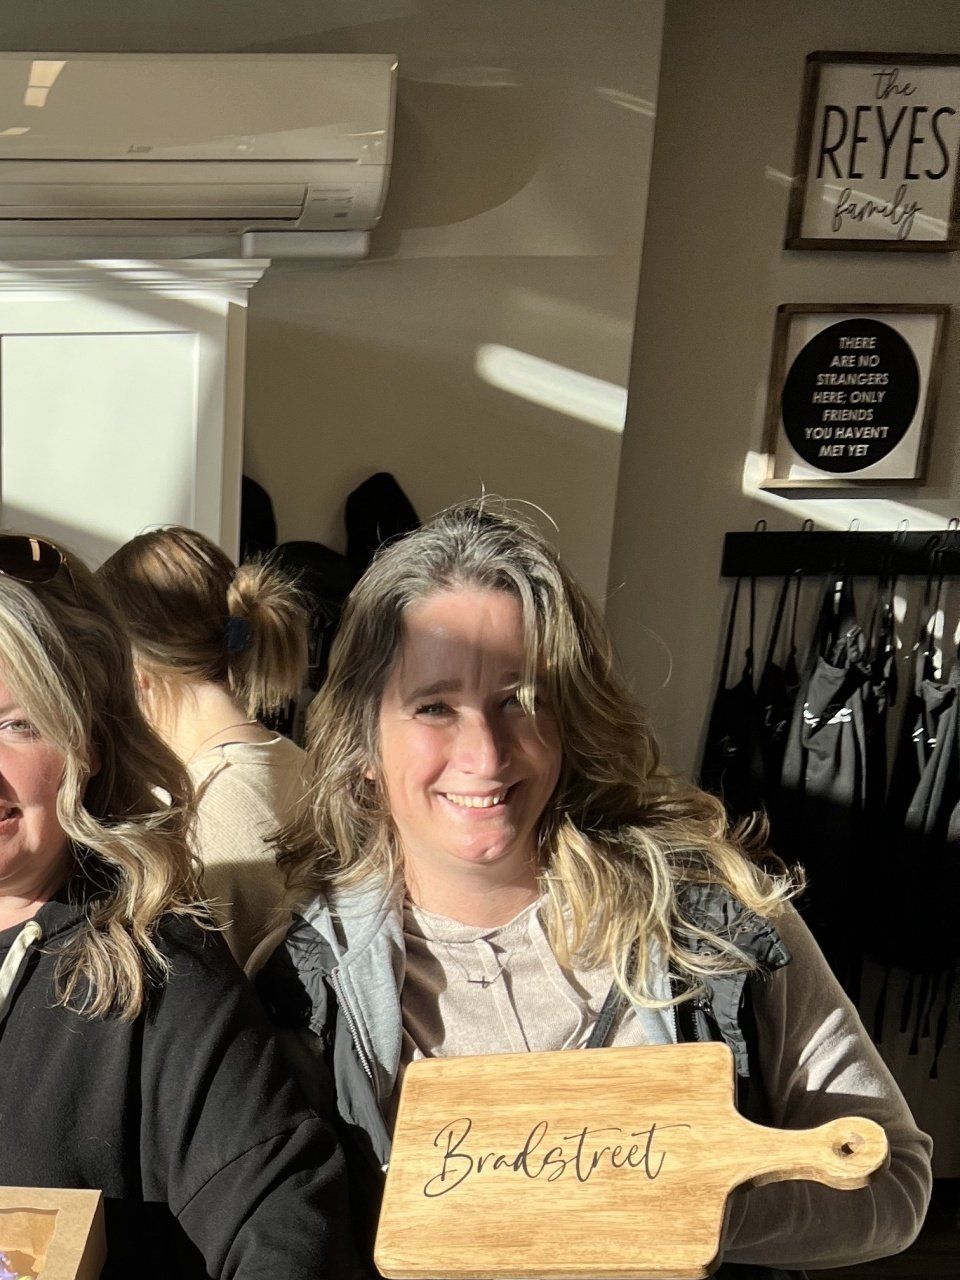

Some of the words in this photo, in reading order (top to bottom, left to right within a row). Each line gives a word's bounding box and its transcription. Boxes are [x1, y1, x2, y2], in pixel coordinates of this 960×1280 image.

[872, 67, 918, 100] the
[816, 104, 956, 180] REYES
[831, 183, 923, 241] family
[839, 336, 878, 349] THERE
[829, 354, 857, 368] ARE
[857, 354, 881, 368] NO
[816, 372, 890, 386] STRANGERS
[849, 391, 887, 404] ONLY
[822, 409, 875, 422] FRIENDS
[804, 427, 833, 441] YOU
[818, 444, 846, 458] MET
[846, 444, 871, 457] YET
[423, 1117, 692, 1199] Bradstreet
